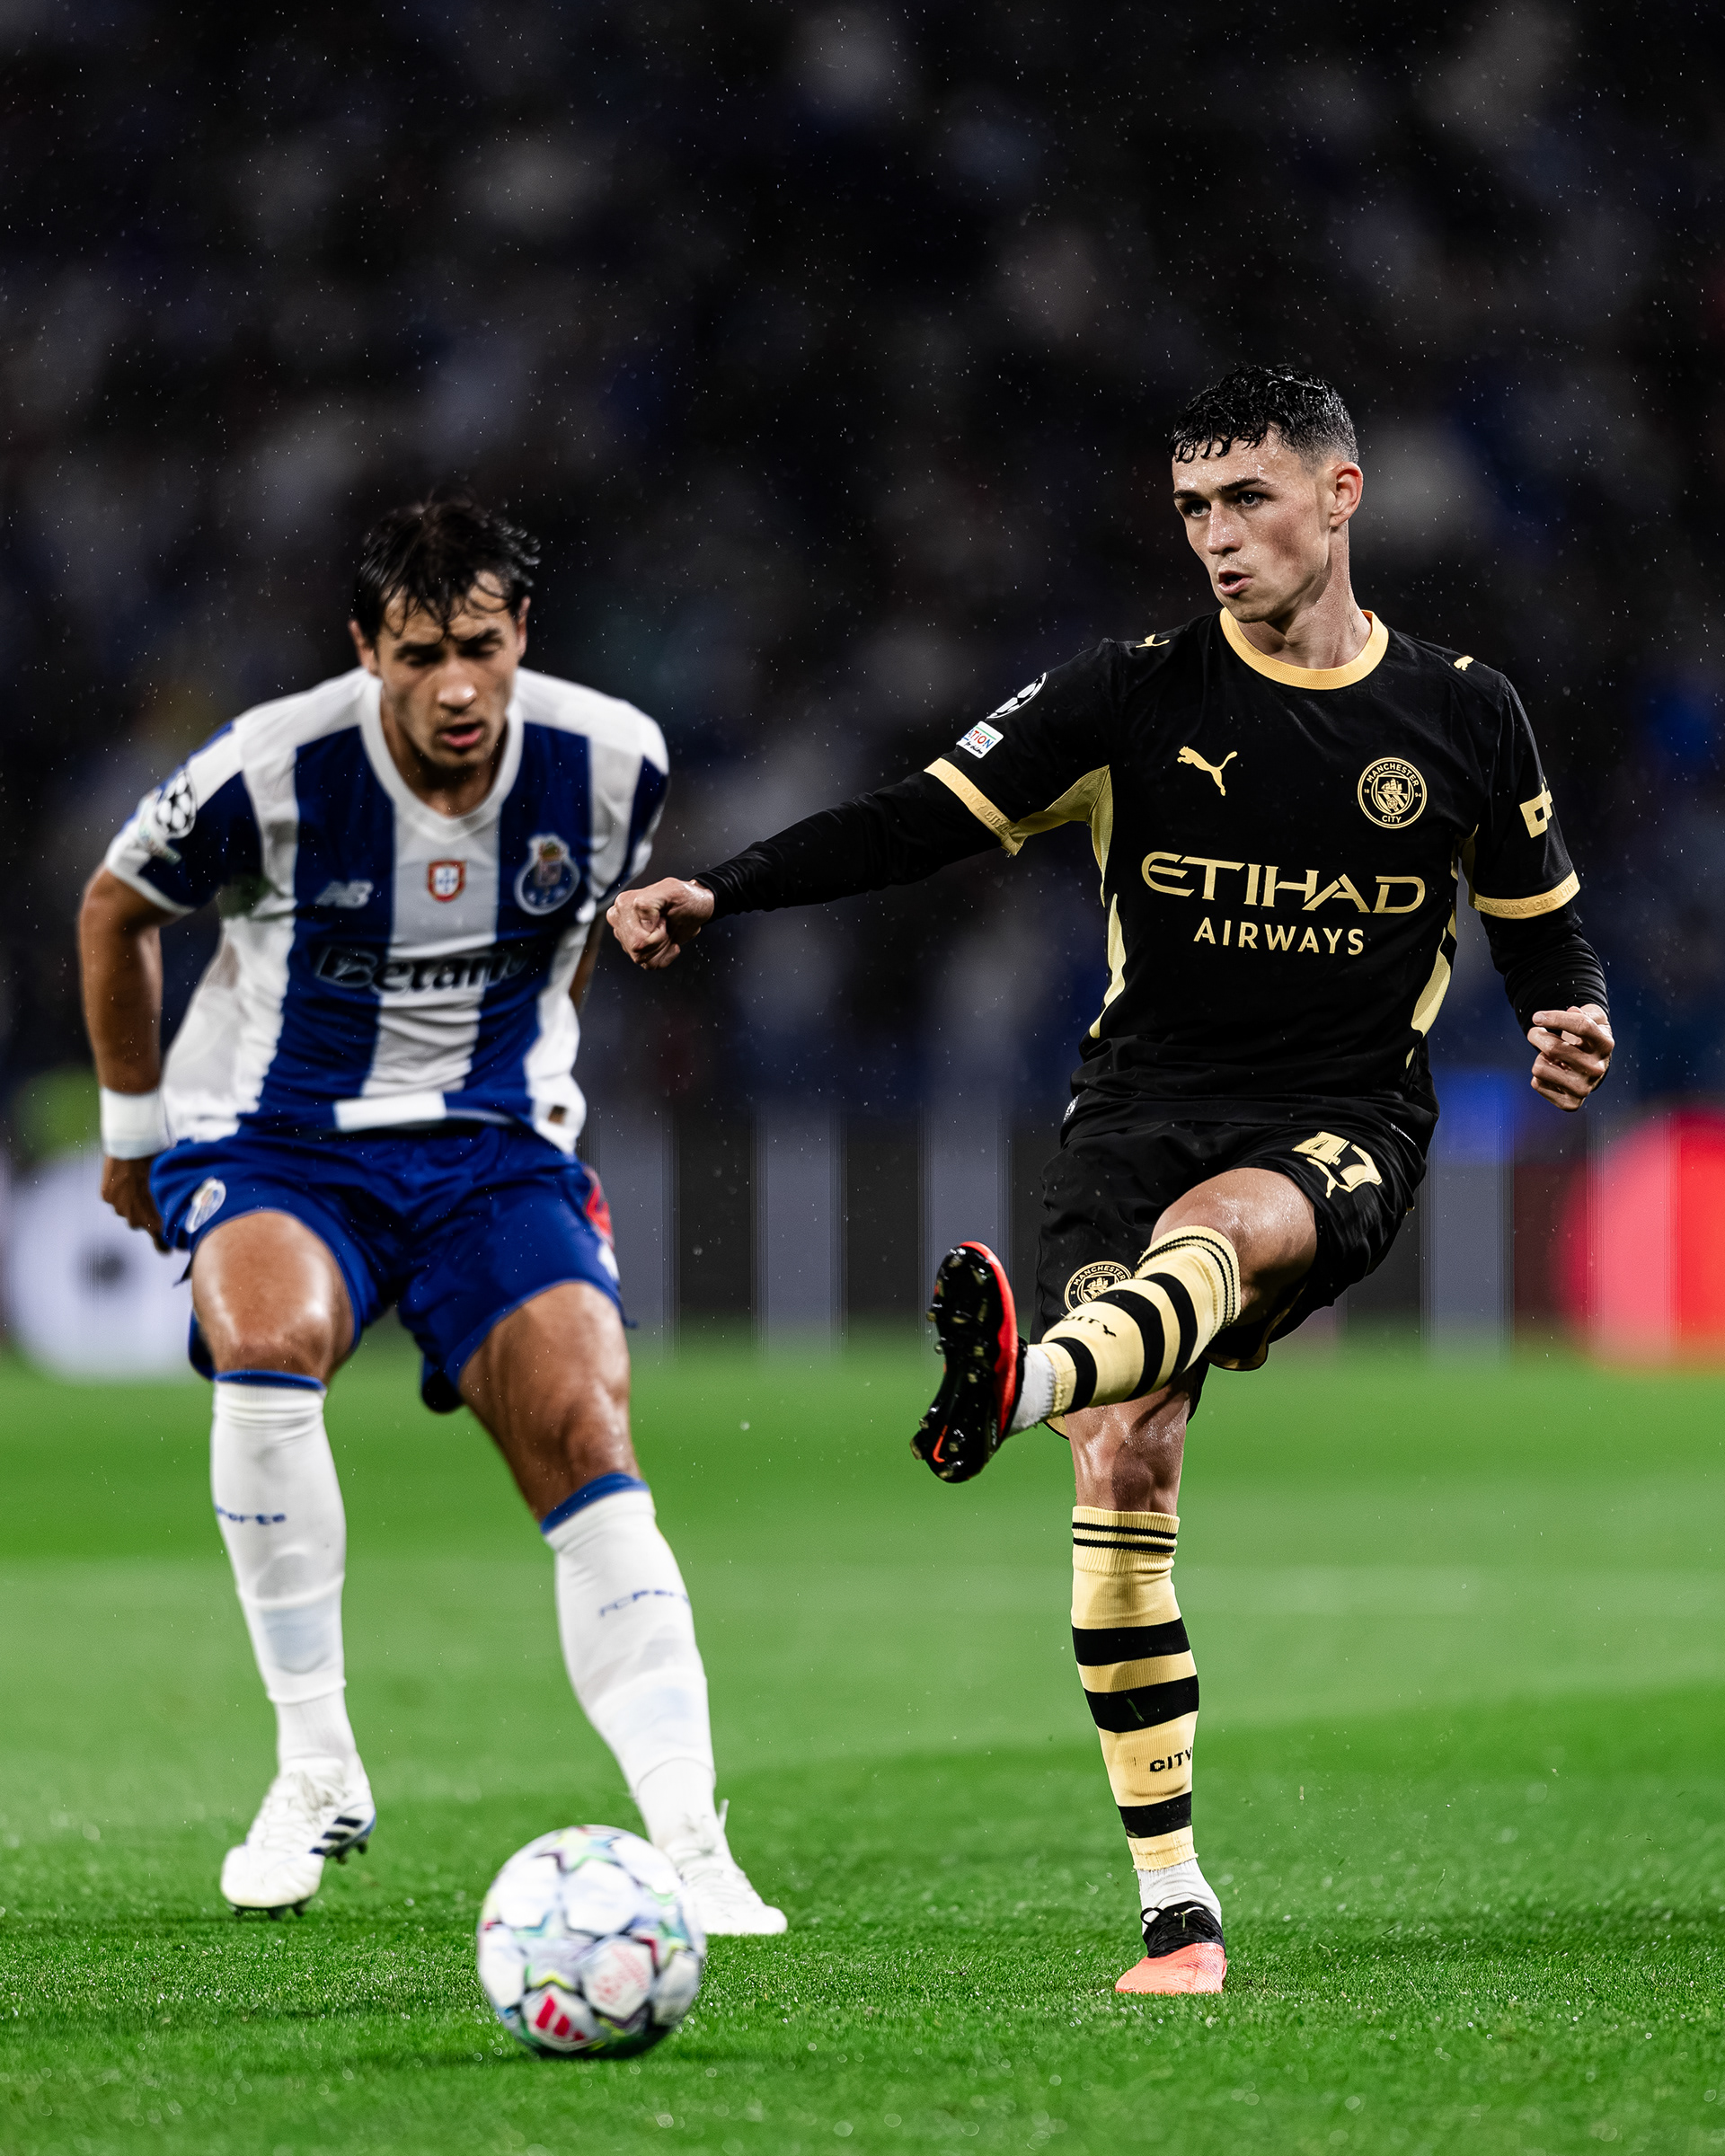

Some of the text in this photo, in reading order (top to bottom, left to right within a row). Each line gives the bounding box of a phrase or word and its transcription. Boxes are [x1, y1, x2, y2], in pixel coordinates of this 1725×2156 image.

[1366, 763, 1420, 787] MANCHESTER
[1382, 815, 1402, 824] CITY
[1141, 851, 1426, 915] ETIHAD
[1193, 916, 1365, 956] AIRWAYS
[1073, 1265, 1127, 1286] MANCHESTER
[1149, 1745, 1192, 1772] CITY
